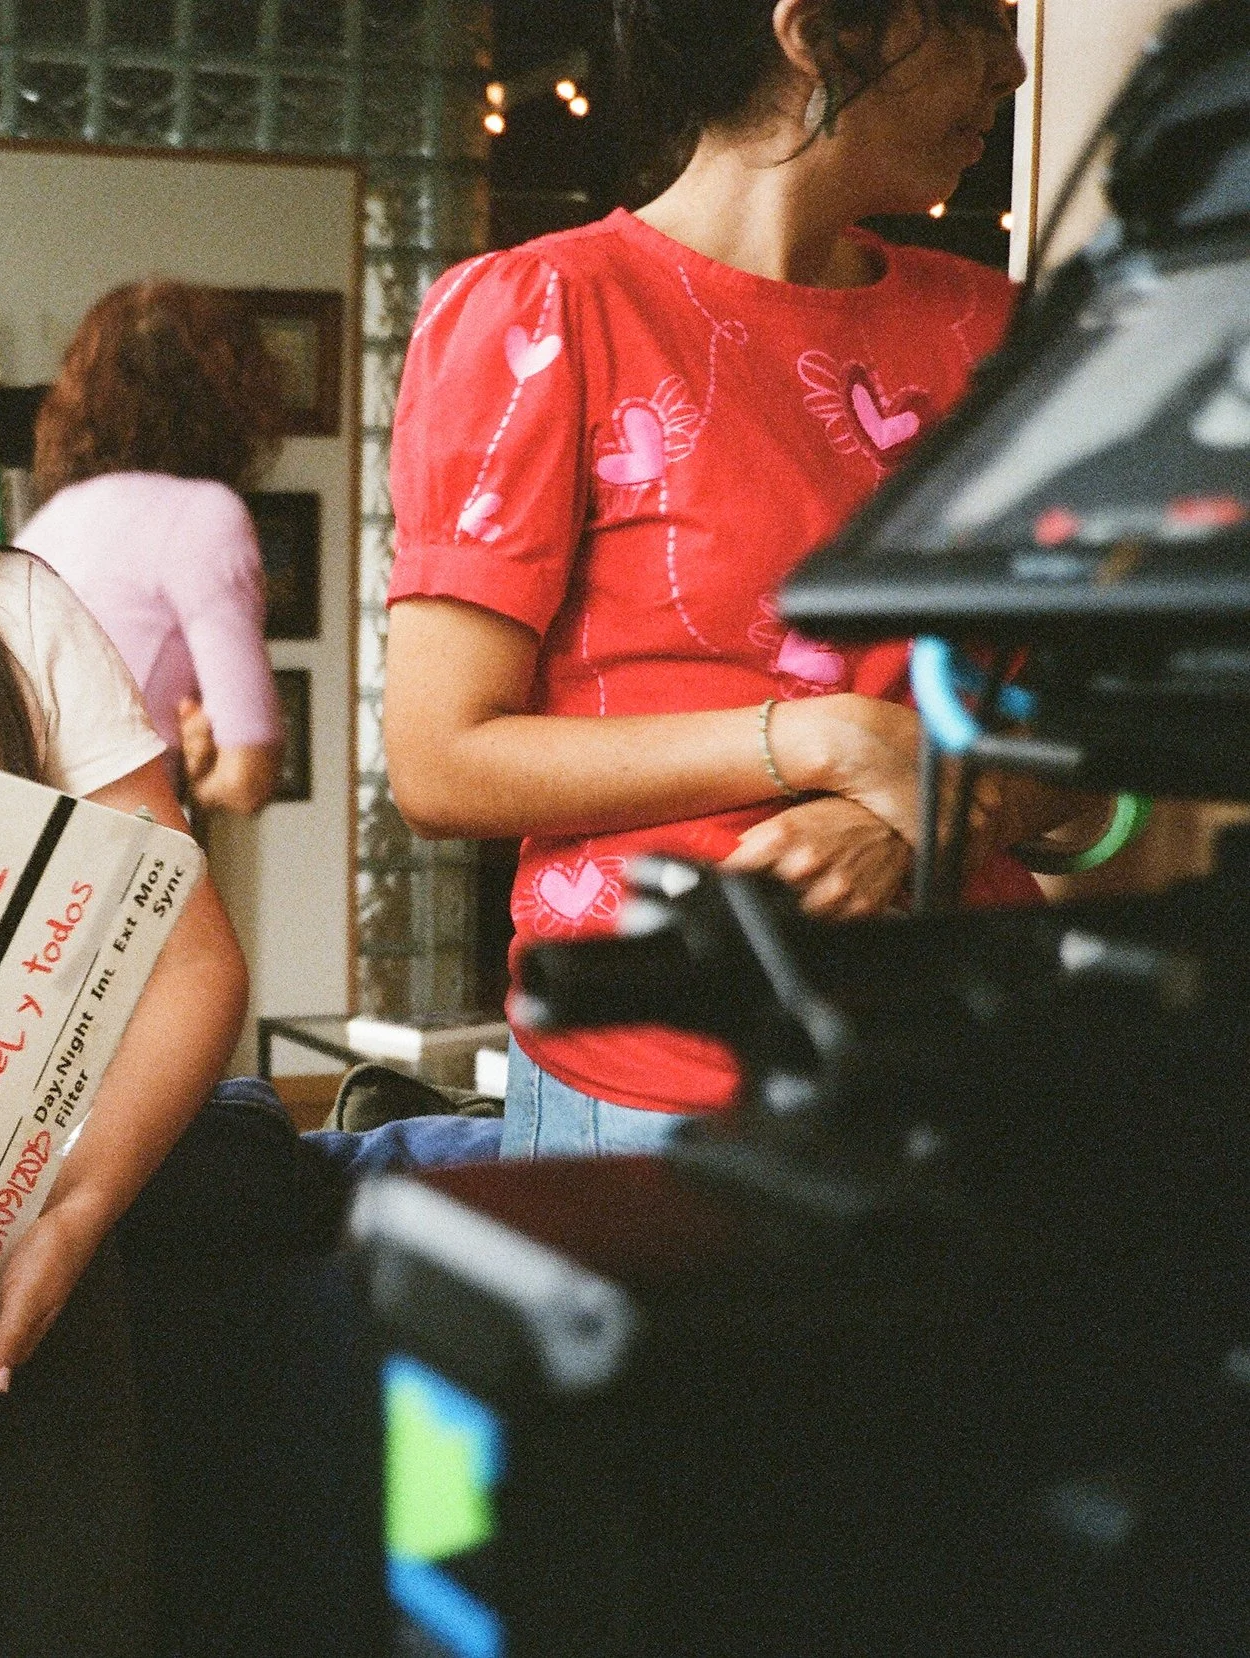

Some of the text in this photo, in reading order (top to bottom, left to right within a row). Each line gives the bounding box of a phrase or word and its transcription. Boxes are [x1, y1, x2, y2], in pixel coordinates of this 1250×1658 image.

[111, 916, 138, 954] Ext
[133, 857, 165, 909] Mos
[152, 865, 185, 919] Sync
[21, 880, 95, 975] todos
[16, 993, 44, 1018] y
[54, 1068, 89, 1128] Filter
